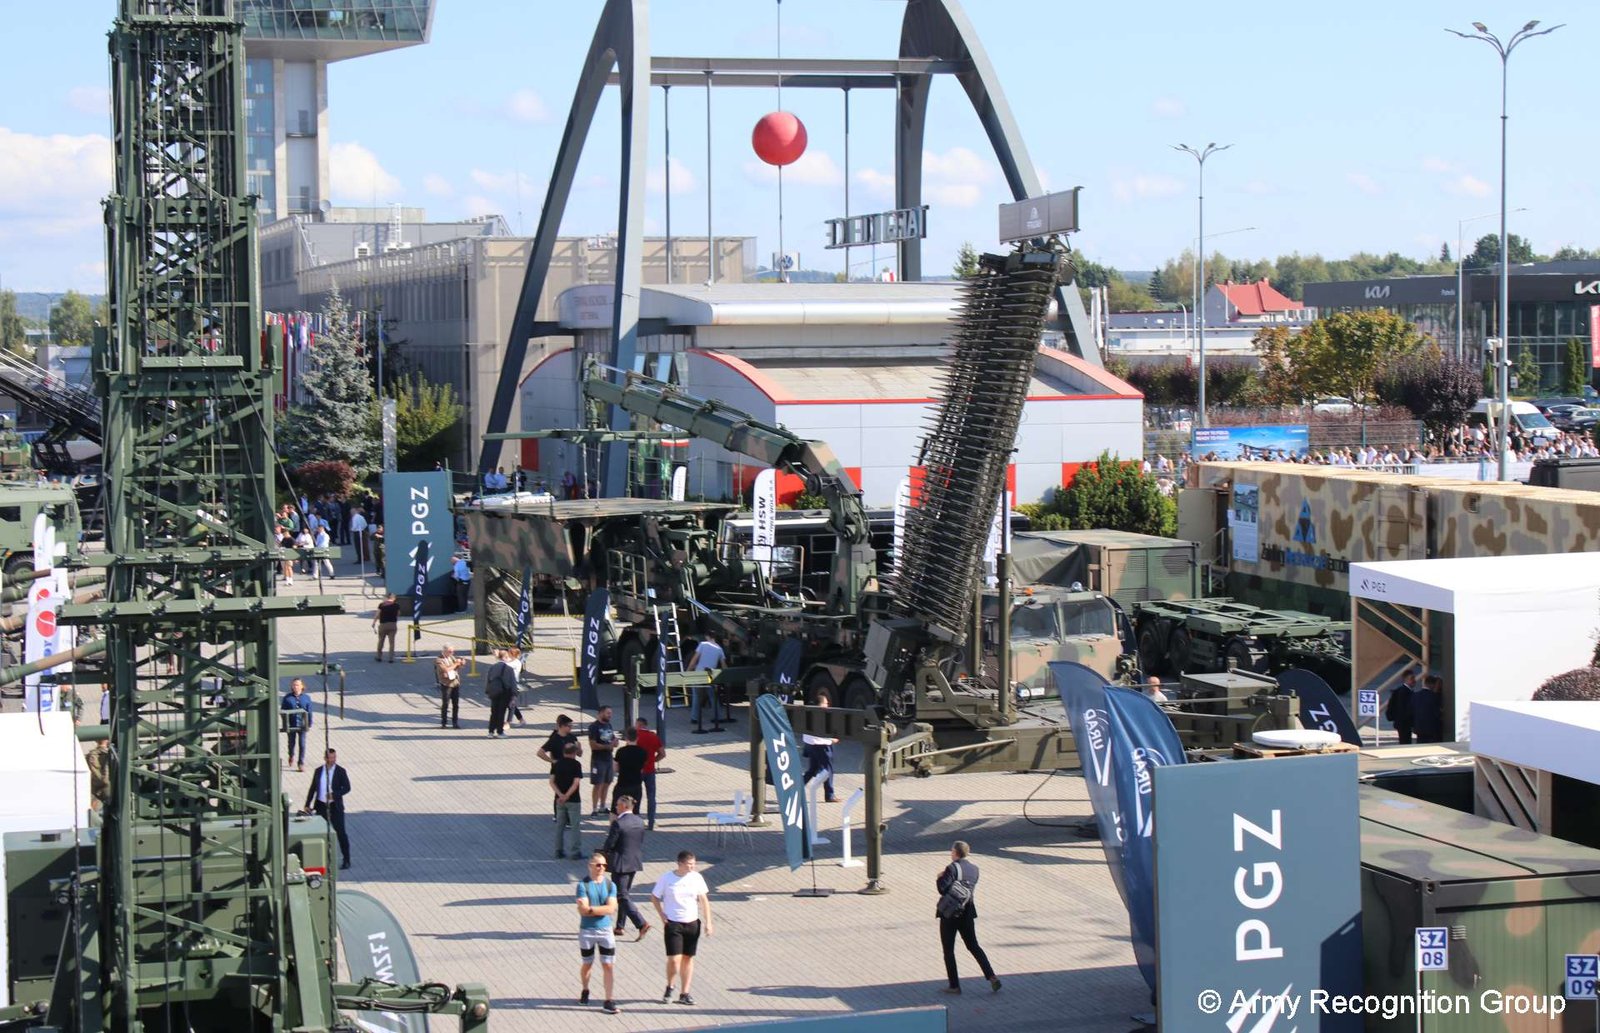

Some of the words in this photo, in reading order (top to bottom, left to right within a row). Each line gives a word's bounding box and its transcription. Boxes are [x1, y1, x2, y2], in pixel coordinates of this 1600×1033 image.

[410, 486, 430, 535] PGZ
[415, 563, 426, 596] PGZ
[1372, 581, 1387, 593] PGZ
[518, 589, 529, 625] PGZ
[588, 617, 600, 658] PGZ
[1360, 692, 1375, 702] 3Z
[1361, 704, 1376, 714] 04
[773, 732, 794, 791] PGZ
[1233, 809, 1284, 961] PGZ
[1420, 931, 1444, 947] 3Z
[1422, 952, 1443, 966] 08
[1569, 958, 1595, 974] 3Z
[1571, 980, 1595, 995] 09
